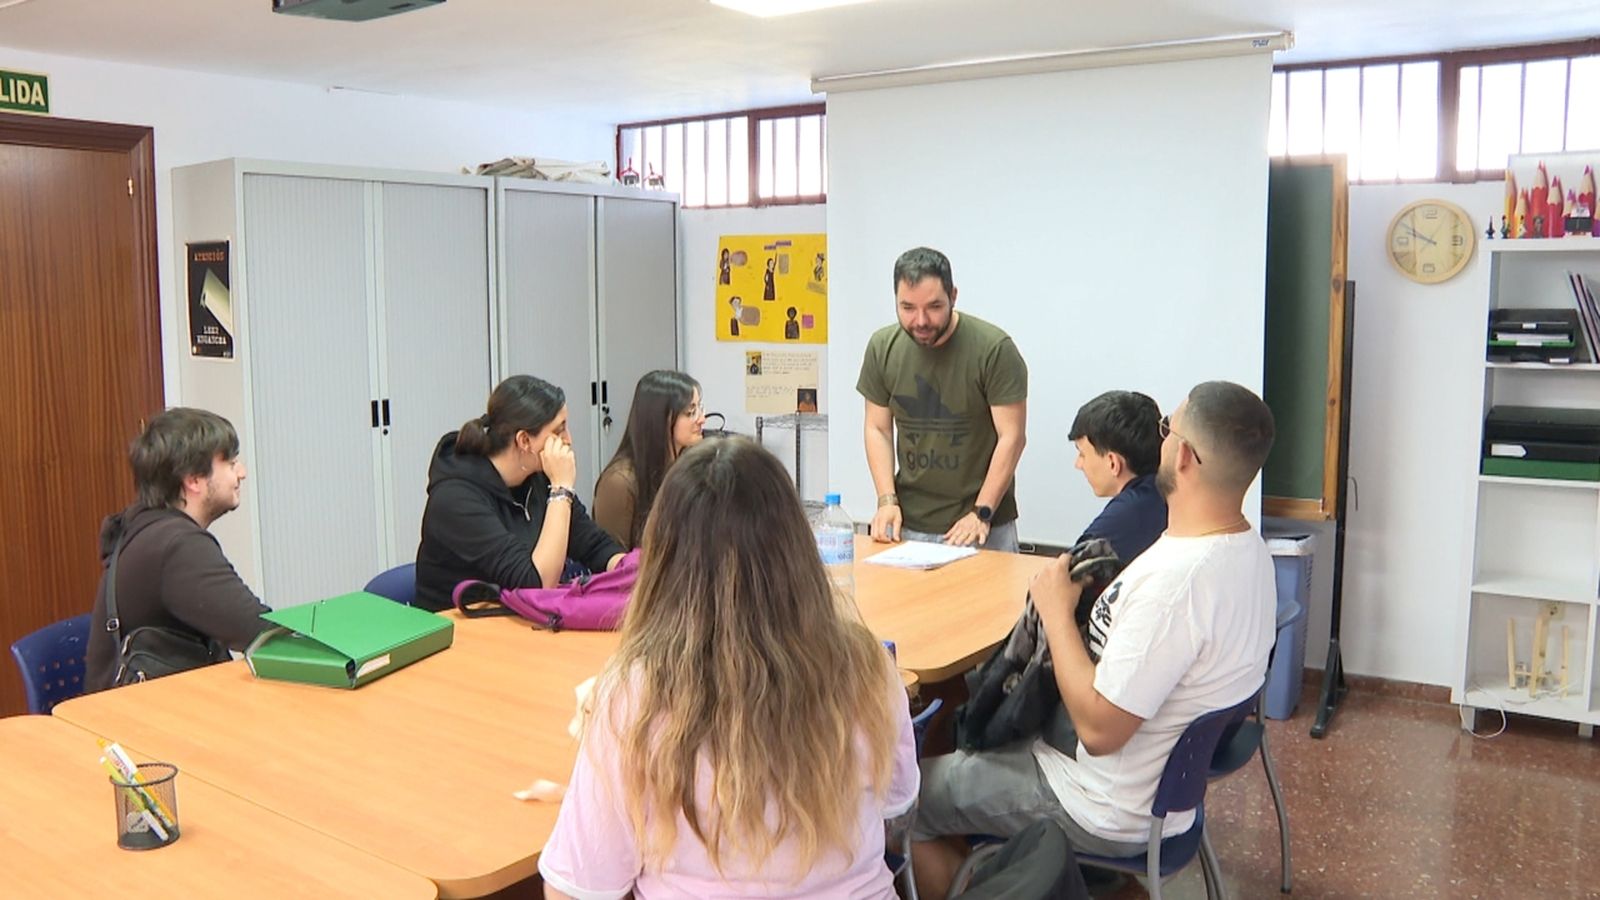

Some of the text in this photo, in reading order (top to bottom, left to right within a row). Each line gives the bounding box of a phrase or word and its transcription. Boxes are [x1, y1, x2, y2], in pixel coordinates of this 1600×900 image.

[0, 78, 45, 106] LIDA
[203, 325, 219, 335] LEER
[906, 448, 960, 471] goku
